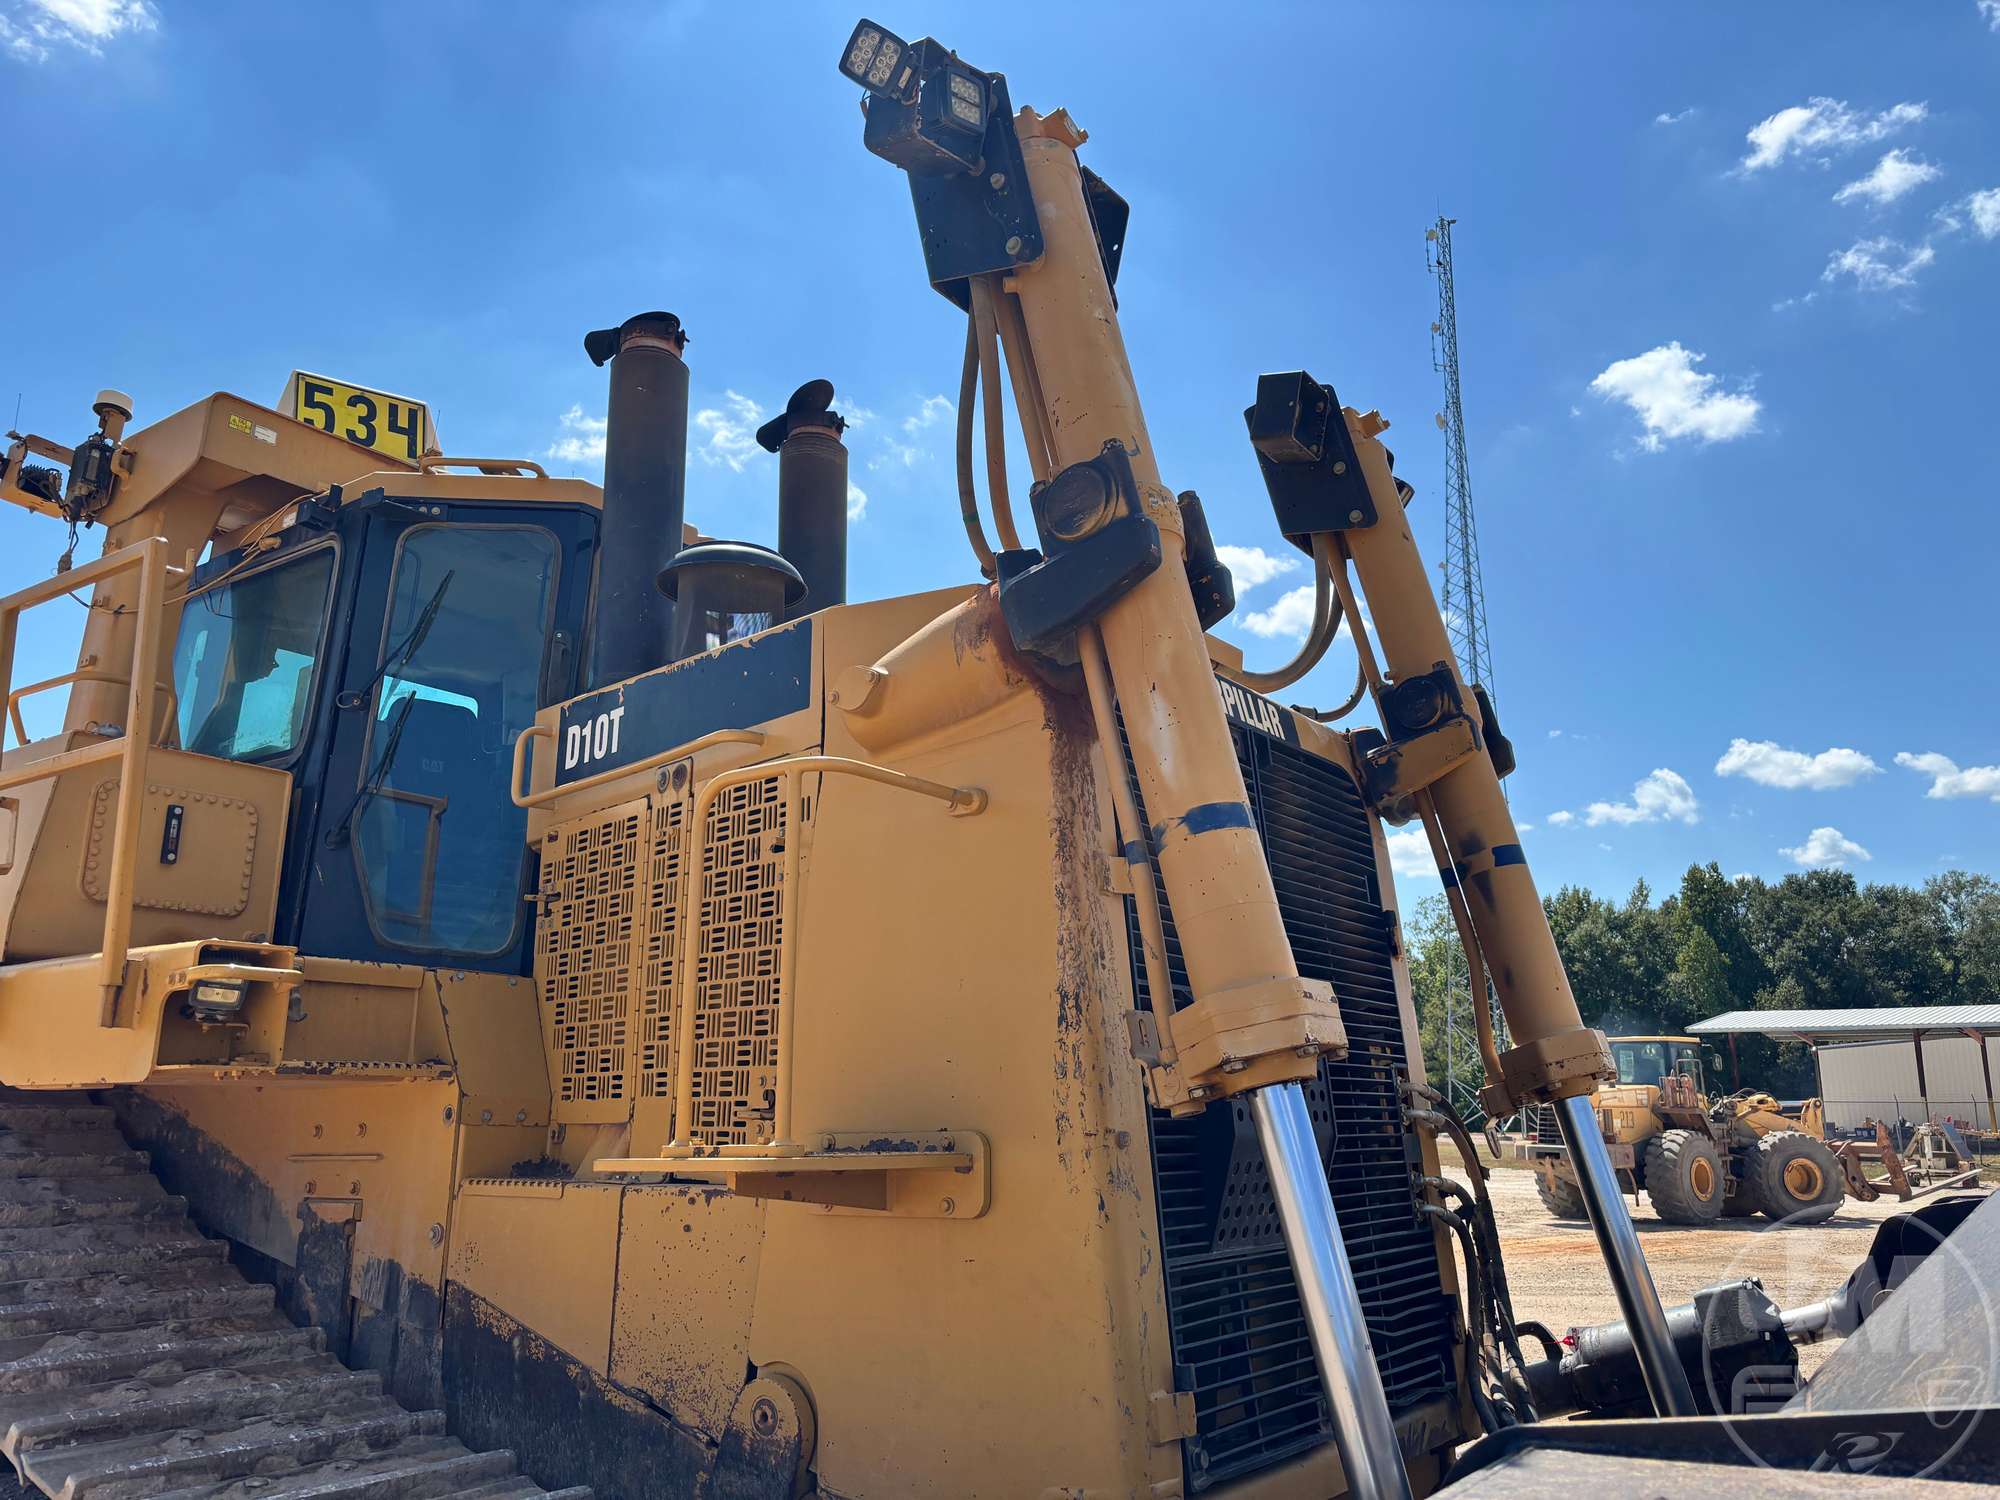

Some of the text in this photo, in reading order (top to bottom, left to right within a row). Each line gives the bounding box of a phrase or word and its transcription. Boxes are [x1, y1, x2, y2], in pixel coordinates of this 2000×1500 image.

[304, 381, 418, 459] 534
[565, 706, 625, 770] D10T
[1216, 680, 1286, 741] PILLAR
